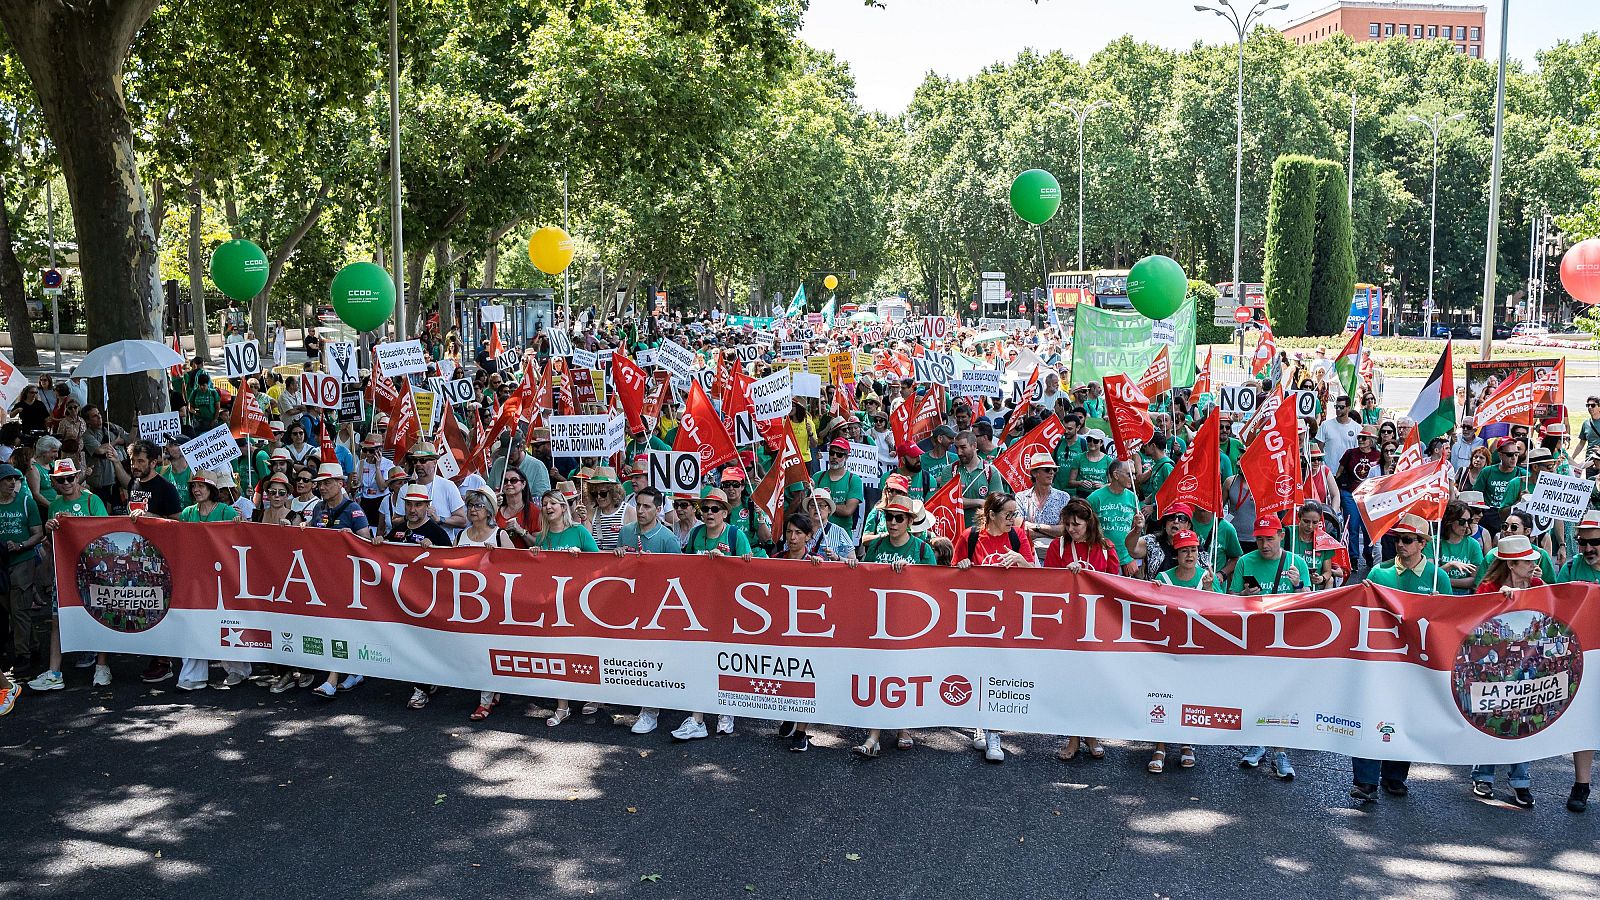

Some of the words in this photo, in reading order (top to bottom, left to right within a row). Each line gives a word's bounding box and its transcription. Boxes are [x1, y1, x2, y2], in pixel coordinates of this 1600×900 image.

[923, 317, 946, 338] NO
[548, 329, 572, 356] NO
[226, 342, 258, 376] NO
[500, 349, 518, 370] NO
[736, 346, 758, 361] NO
[618, 361, 645, 391] GT
[914, 358, 946, 385] NO
[302, 374, 340, 407] NO
[441, 379, 474, 403] NO
[754, 384, 769, 399] POCA
[1013, 380, 1043, 402] NO
[1107, 381, 1141, 403] UG
[1221, 387, 1255, 411] NO
[755, 402, 773, 416] POCA
[141, 419, 167, 434] CALLAR
[169, 417, 179, 429] ES
[557, 424, 568, 437] PP:
[569, 422, 606, 437] DES-EDUCAR
[681, 413, 702, 446] GT
[736, 413, 754, 444] N
[551, 440, 570, 452] PARA
[571, 438, 607, 452] DOMINAR.
[1042, 422, 1061, 450] UG
[182, 440, 204, 455] Escuela
[203, 438, 209, 446] y
[194, 440, 228, 461] PRIVATIZAN
[194, 461, 210, 473] PARA
[211, 447, 239, 467] ENGAÑAR
[847, 461, 858, 472] HAY
[650, 453, 700, 491] NO
[1539, 474, 1562, 487] Escuela
[1562, 480, 1568, 490] y
[1568, 481, 1593, 493] medios:
[1542, 489, 1581, 505] PRIVATIZAN
[1531, 501, 1550, 513] PARA
[1551, 504, 1583, 519] ENGAÑAR
[98, 587, 110, 597] LA
[114, 586, 157, 599] PÚBLICA
[96, 598, 109, 606] SE
[112, 599, 159, 609] DEFIENDE
[214, 545, 327, 610] ¡LA
[346, 551, 709, 631] PÚBLICA
[732, 582, 836, 639] SE
[869, 588, 1430, 661] DEFIENDE!
[371, 655, 391, 663] Madrid
[495, 655, 567, 676] CCOO
[603, 657, 655, 669] educación
[657, 662, 664, 671] y
[717, 652, 815, 678] CONFAPA
[603, 667, 648, 678] servicios
[604, 677, 686, 689] socioeducativos
[851, 674, 933, 708] UGT
[988, 676, 1035, 689] Servicios
[1482, 685, 1500, 698] LA
[1505, 676, 1559, 698] PÚBLICA
[988, 689, 1031, 702] Públicos
[1479, 699, 1494, 711] SE
[1501, 688, 1563, 710] DEFIENDE
[737, 701, 777, 711] COMUNIDAD
[778, 704, 788, 712] DE
[788, 706, 816, 714] MADRID
[988, 702, 1029, 714] Madrid
[1185, 707, 1206, 715] Madrid
[1185, 714, 1212, 725] PSOE
[1315, 713, 1362, 729] Podemos
[1326, 725, 1355, 737] Madrid
